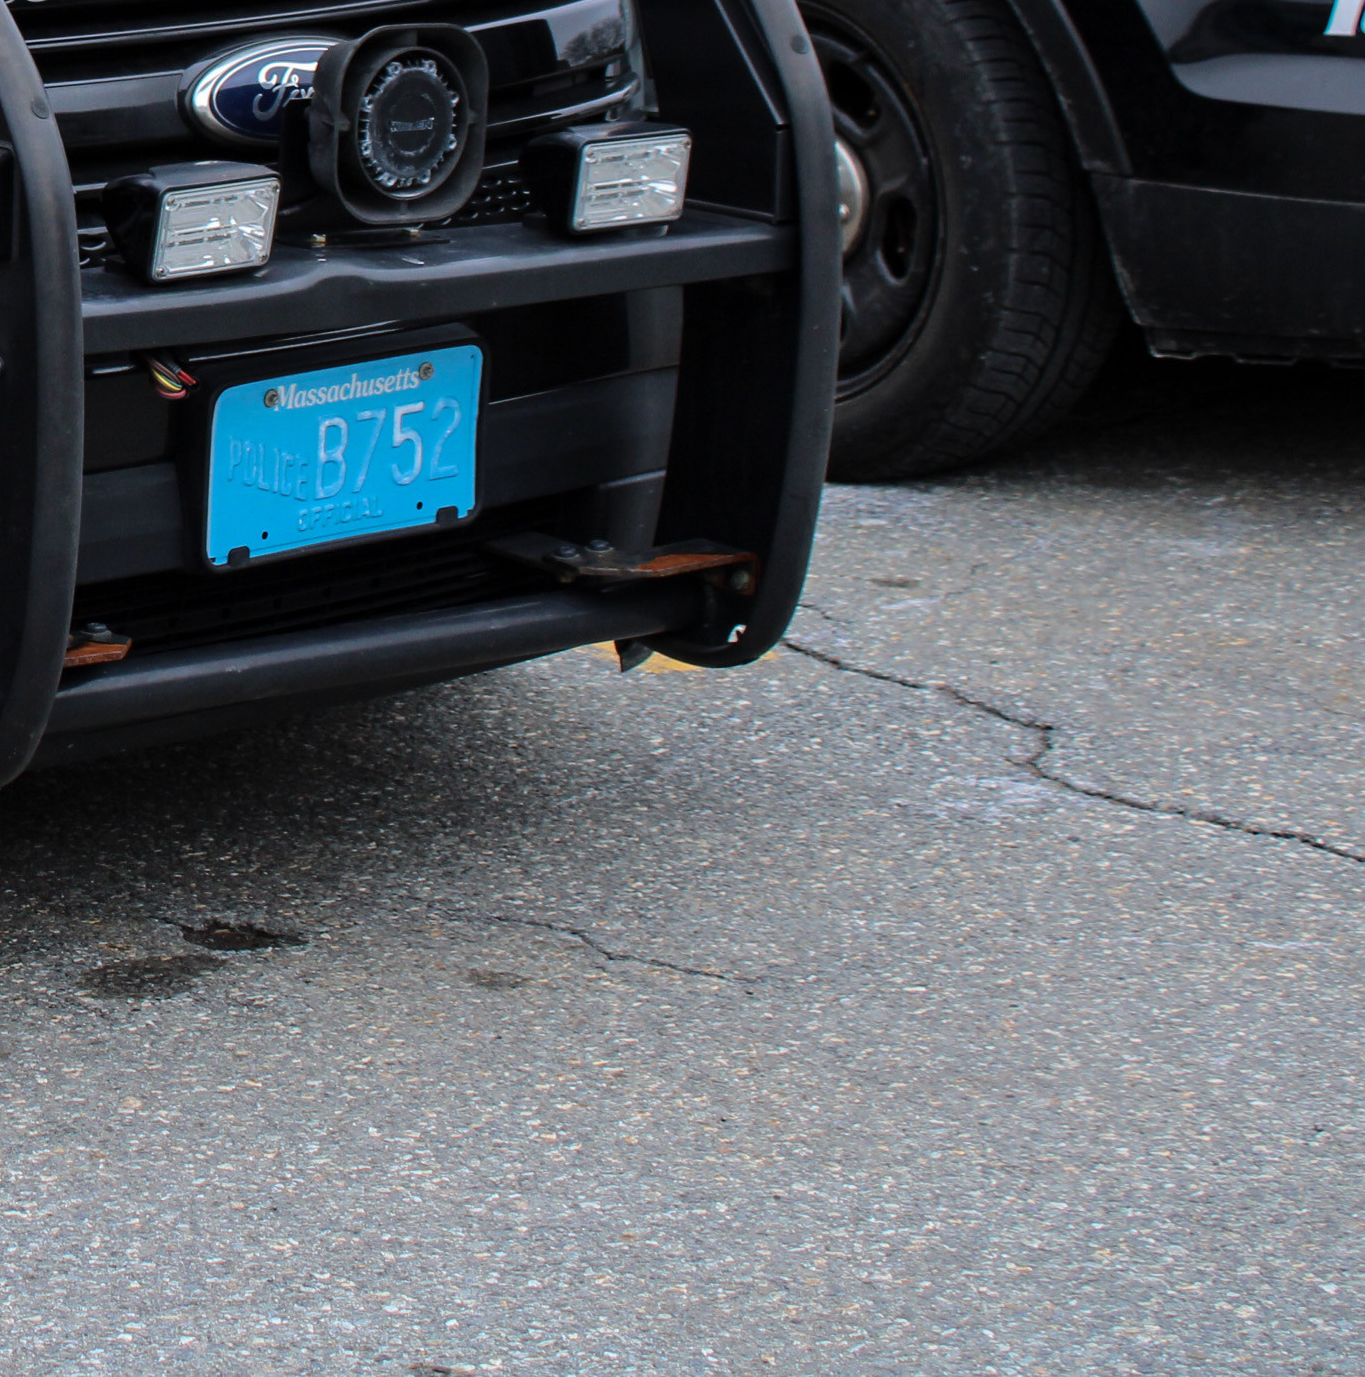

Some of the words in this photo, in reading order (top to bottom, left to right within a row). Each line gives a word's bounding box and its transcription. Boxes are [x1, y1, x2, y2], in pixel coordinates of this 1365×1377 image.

[273, 368, 420, 412] Massachusetts
[227, 436, 309, 502] POLICE
[314, 397, 462, 500] B752
[297, 497, 384, 533] OFFICIAL
